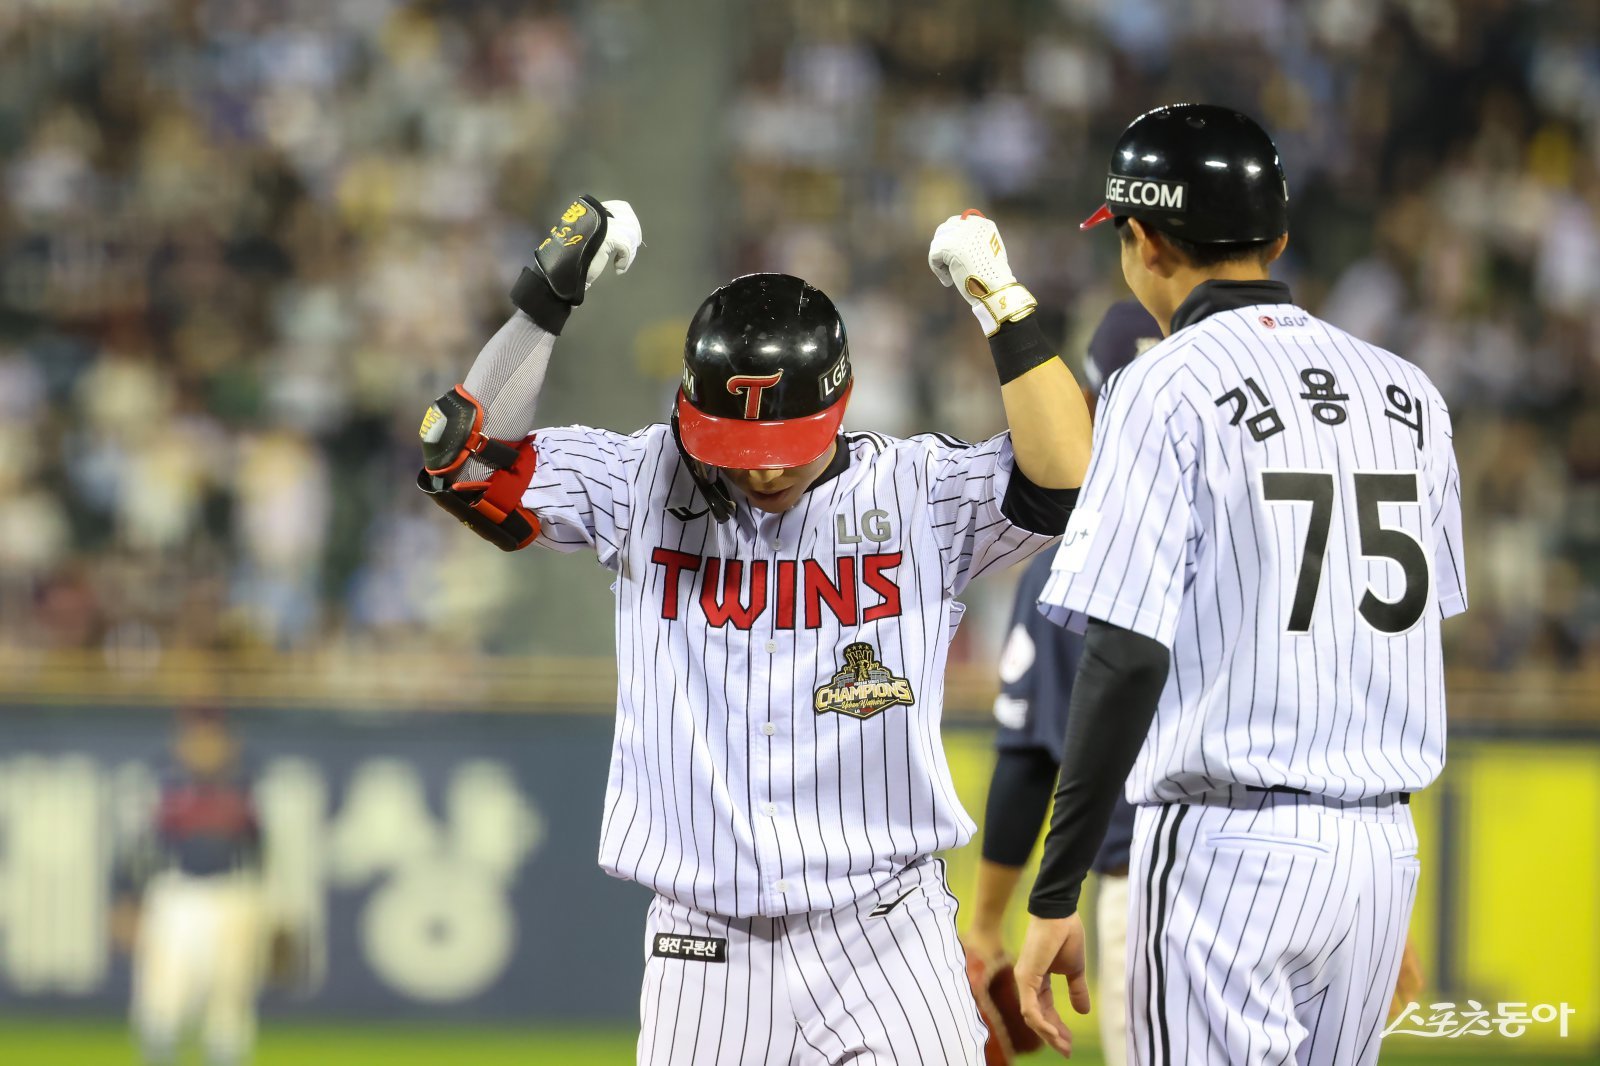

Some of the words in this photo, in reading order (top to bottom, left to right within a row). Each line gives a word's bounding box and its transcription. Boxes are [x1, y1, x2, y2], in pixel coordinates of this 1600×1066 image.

[727, 368, 784, 420] T
[836, 509, 893, 545] LG
[1261, 470, 1430, 635] 75
[651, 547, 904, 630] TWINS
[817, 681, 910, 708] CHAMPIONS
